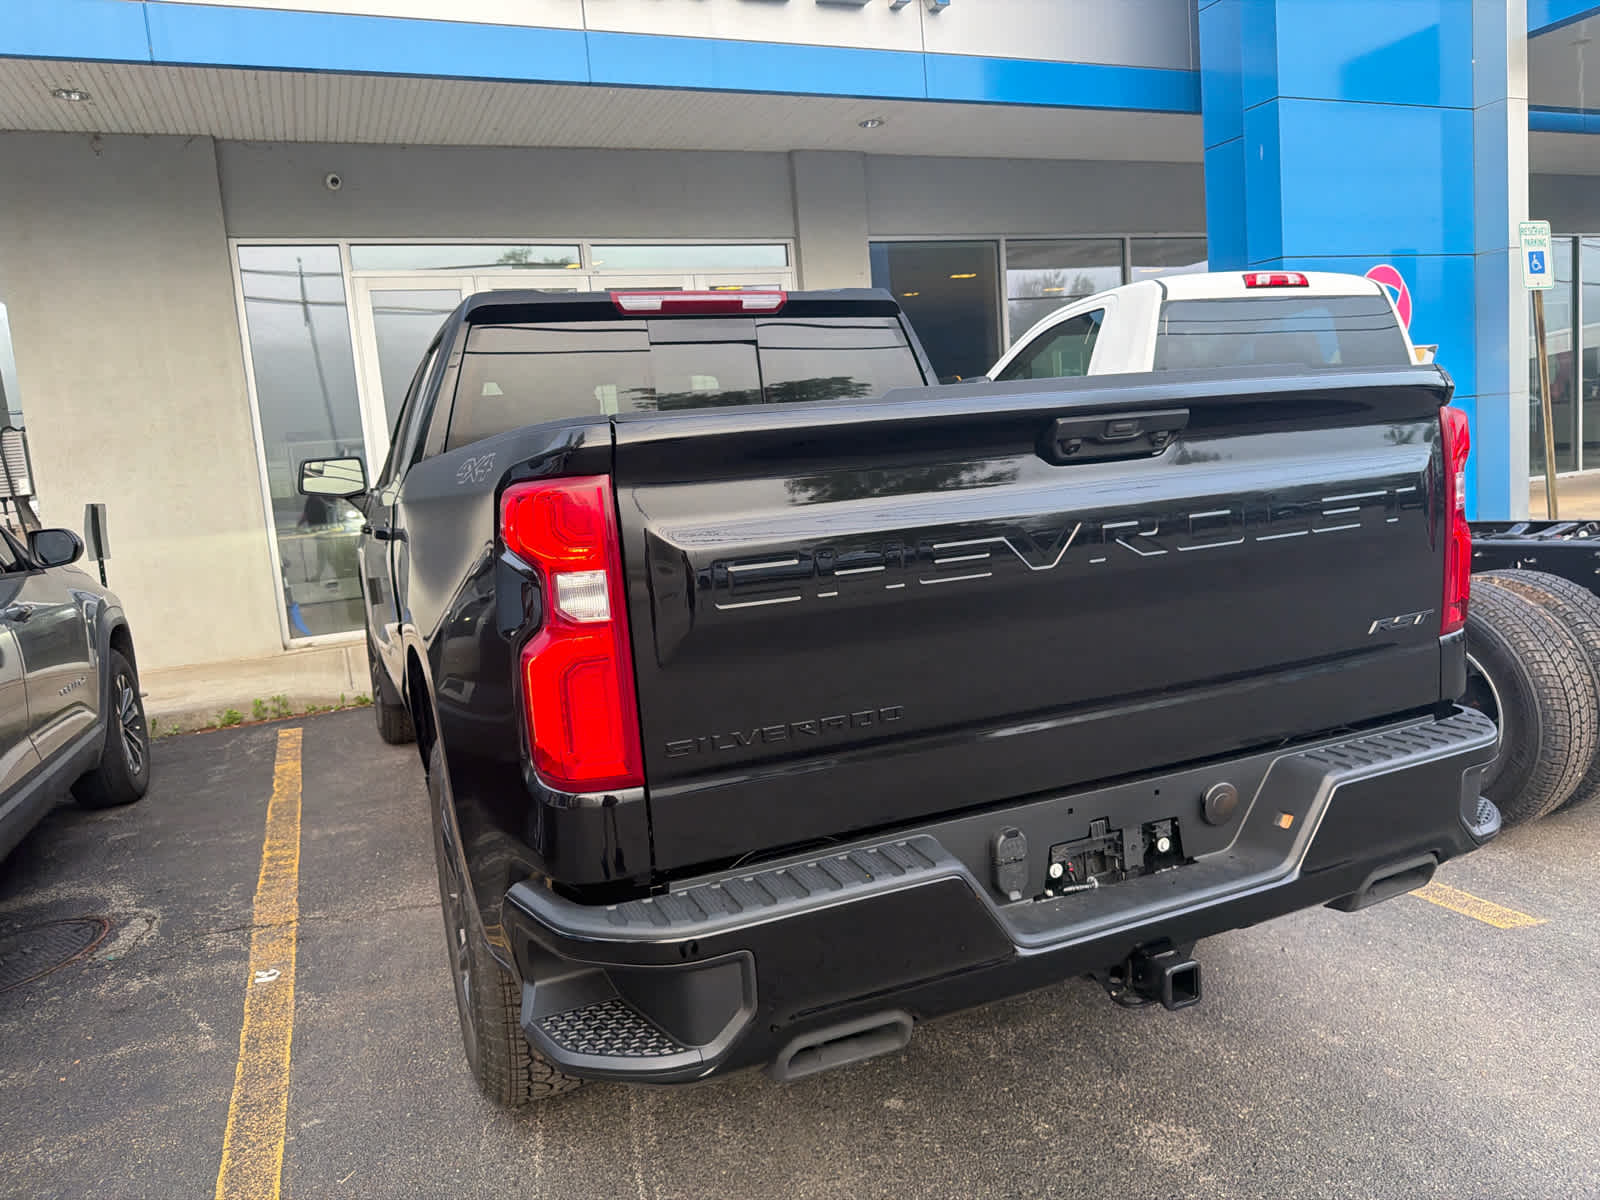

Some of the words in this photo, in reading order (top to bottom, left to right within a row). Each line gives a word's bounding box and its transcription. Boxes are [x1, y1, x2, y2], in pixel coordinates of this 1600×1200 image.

[712, 486, 1416, 610] CHEVROLET
[1367, 608, 1435, 635] RST
[664, 704, 904, 759] SILVERADO
